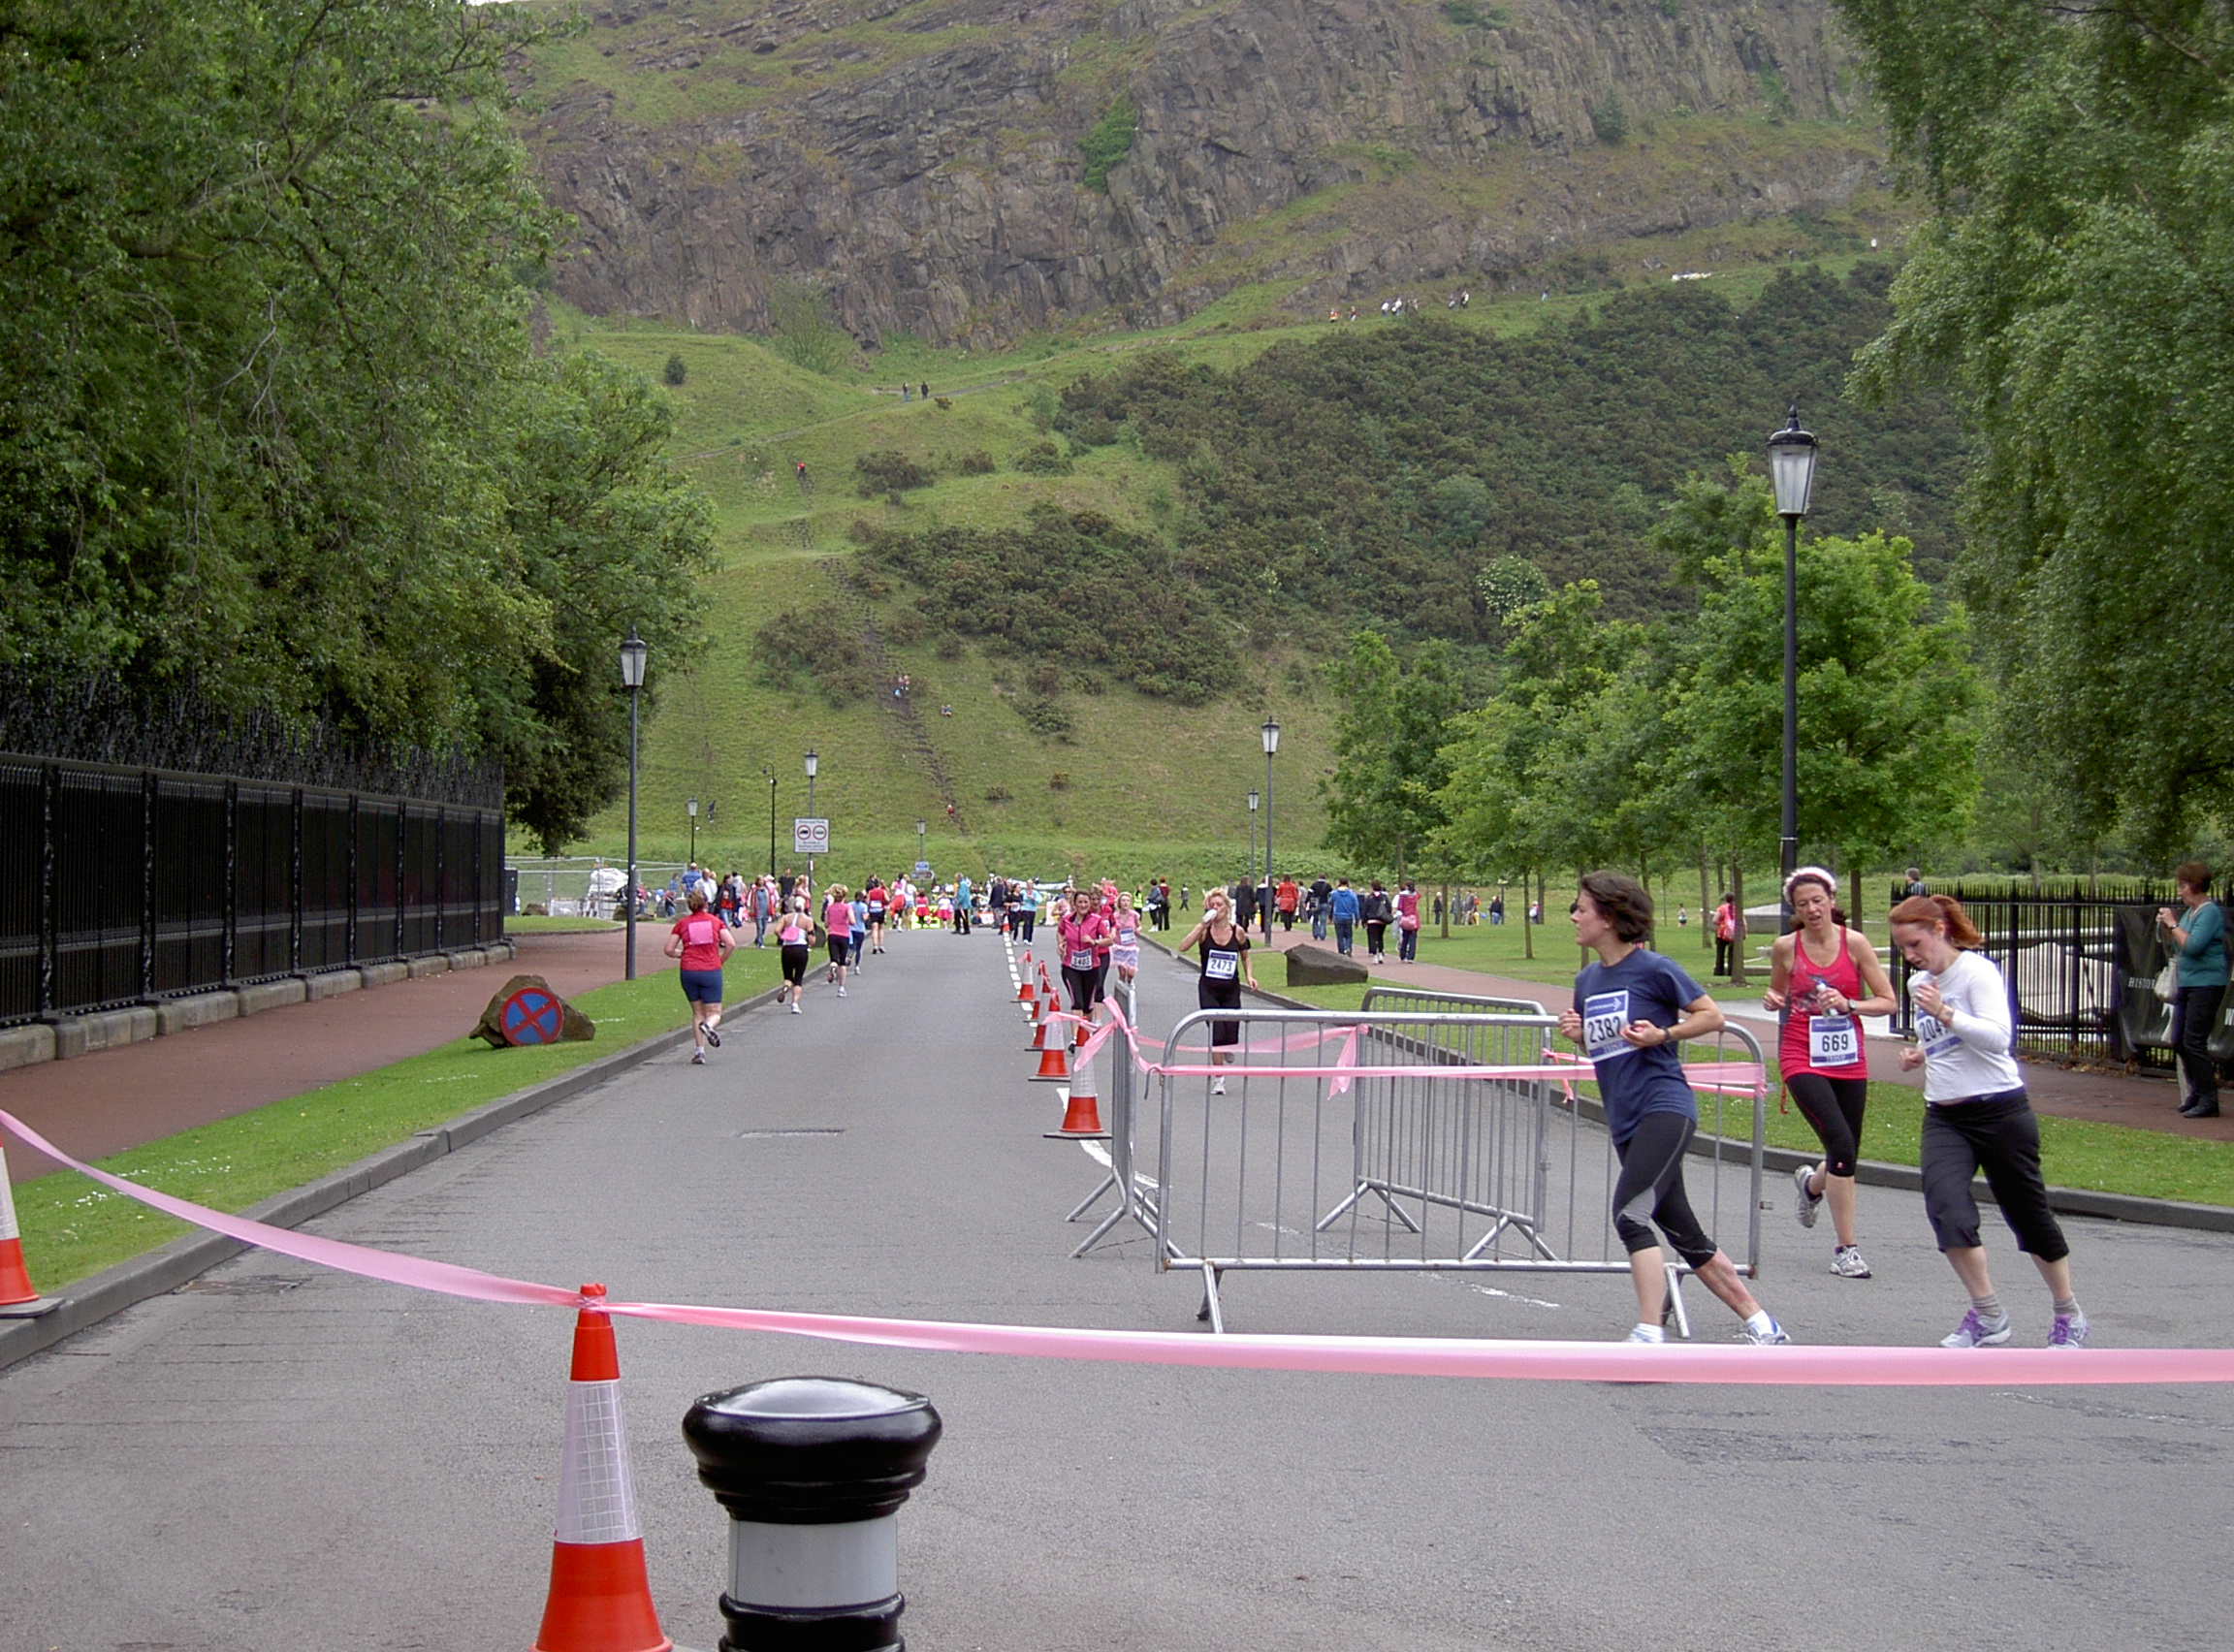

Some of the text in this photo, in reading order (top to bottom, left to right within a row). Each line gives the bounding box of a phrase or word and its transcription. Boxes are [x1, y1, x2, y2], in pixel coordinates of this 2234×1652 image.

[1210, 959, 1233, 972] 2473
[1587, 1015, 1621, 1043] 2382
[1919, 1018, 1949, 1042] 204
[1822, 1033, 1849, 1052] 669
